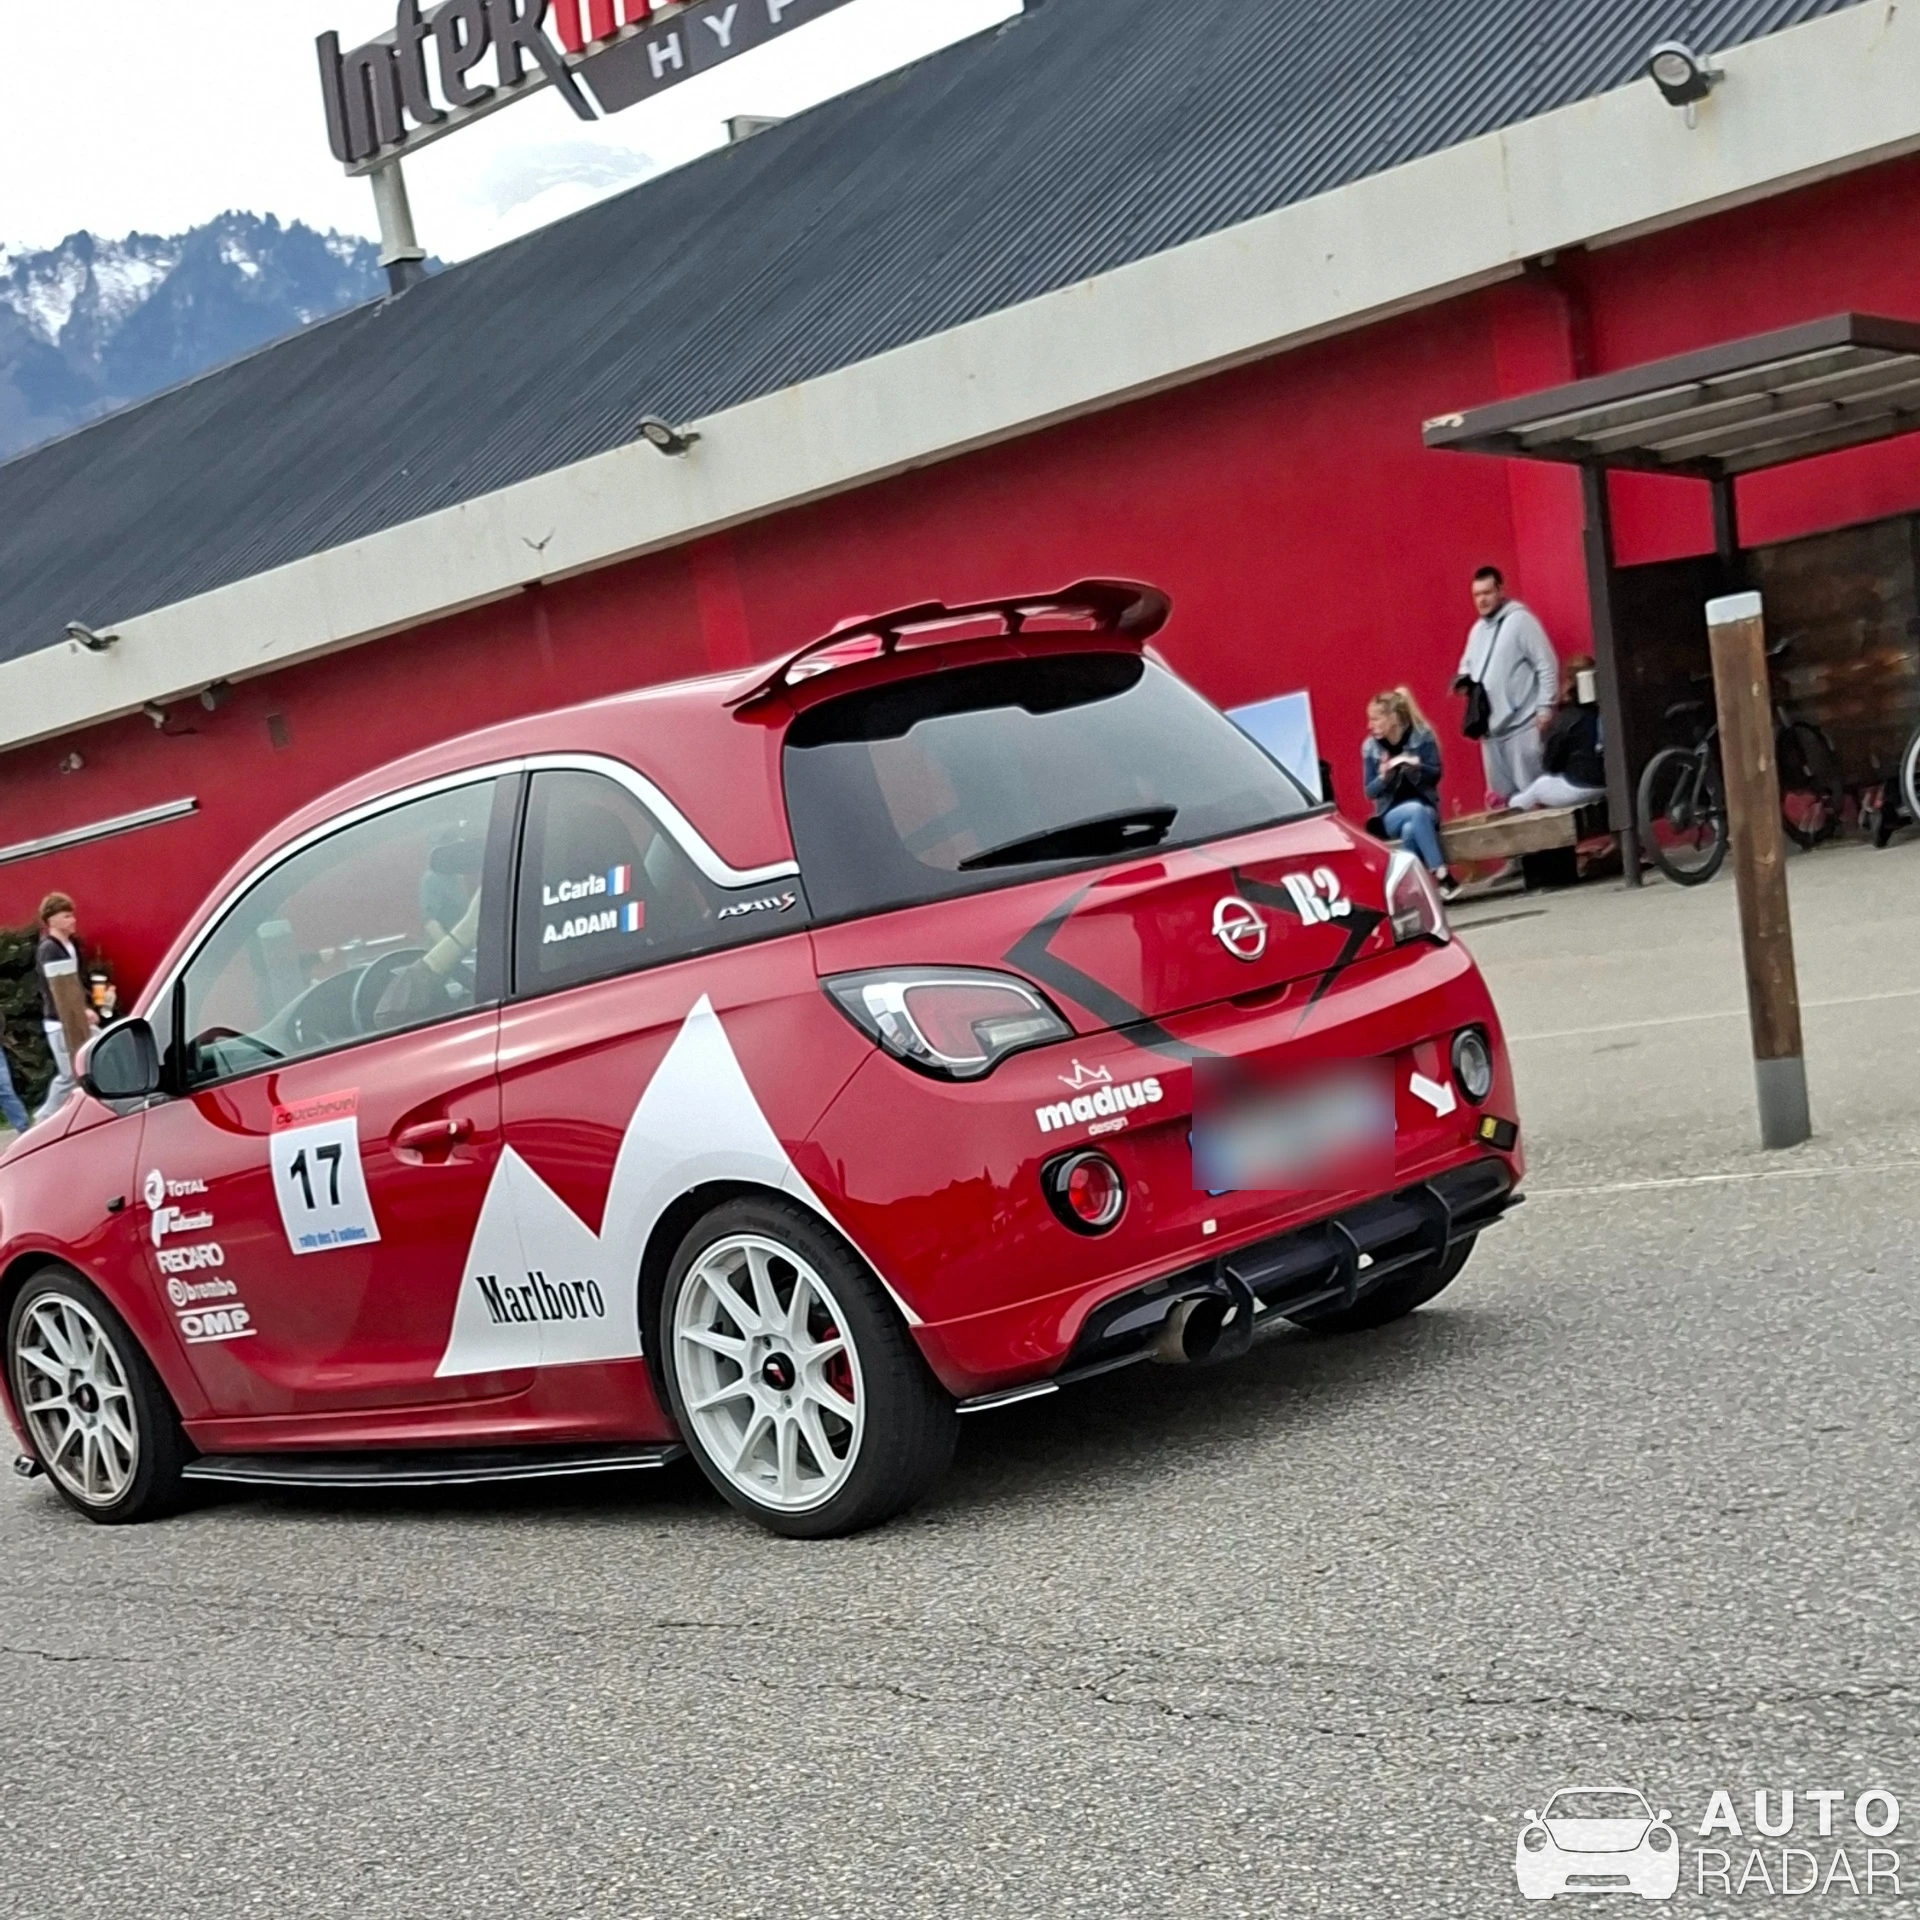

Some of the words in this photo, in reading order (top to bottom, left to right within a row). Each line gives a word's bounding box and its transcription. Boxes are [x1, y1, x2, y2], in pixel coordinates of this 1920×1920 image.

[1281, 867, 1351, 925] R2
[543, 909, 617, 944] A.ADAM
[1035, 1077, 1163, 1133] madius
[289, 1143, 342, 1210] 17
[156, 1242, 224, 1274] RECARO
[184, 1276, 237, 1301] brembo
[475, 1271, 605, 1324] Marlboro
[181, 1309, 250, 1337] OMP
